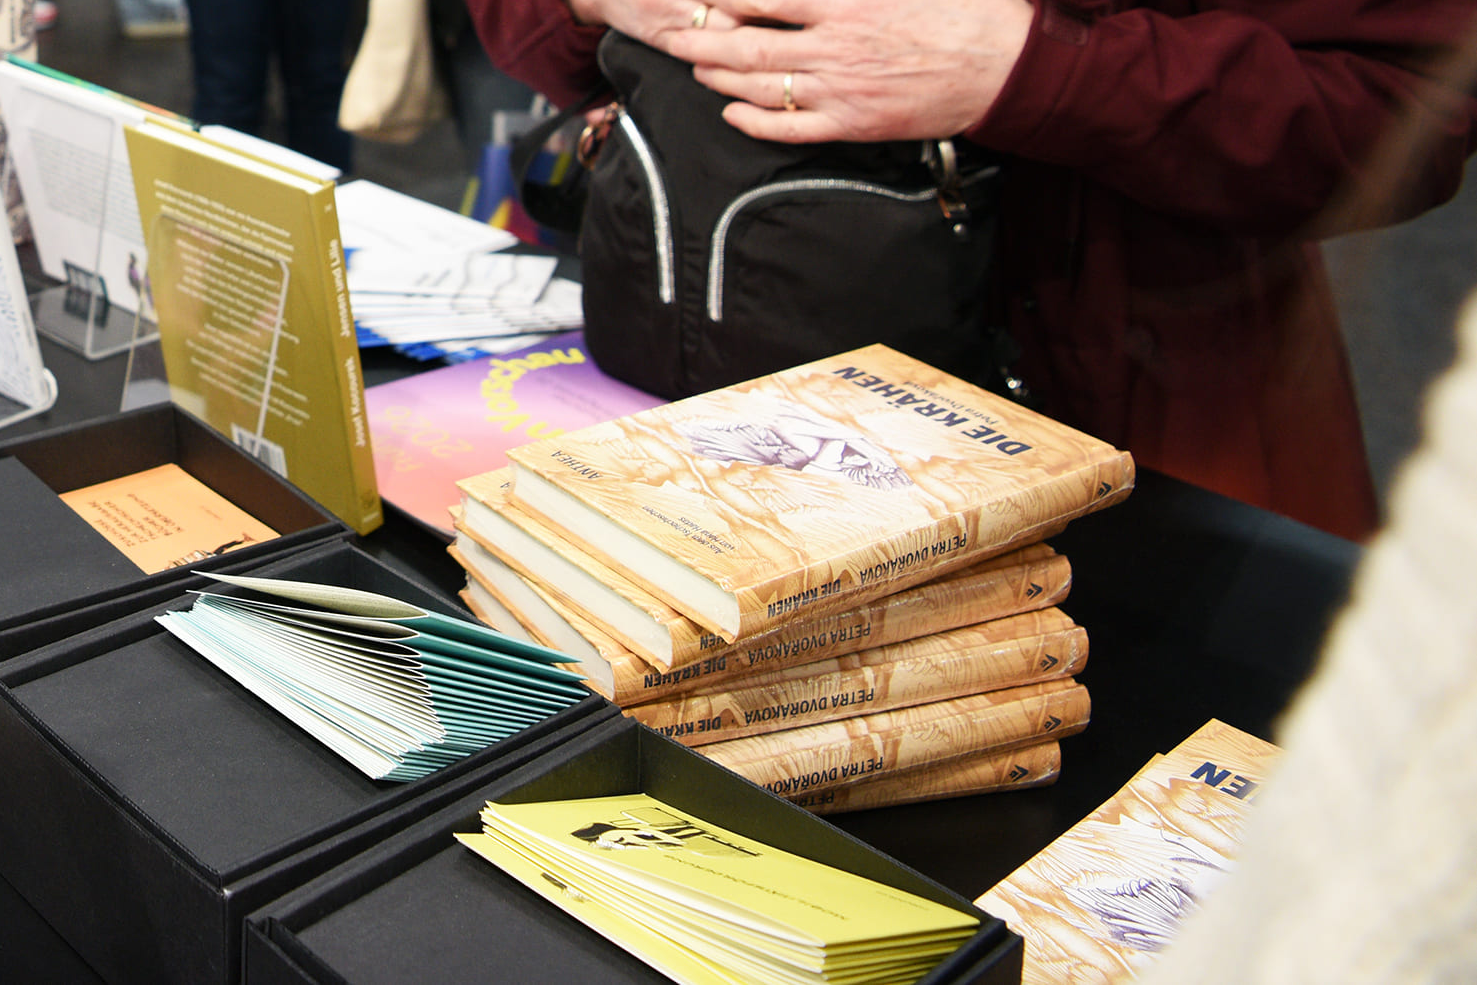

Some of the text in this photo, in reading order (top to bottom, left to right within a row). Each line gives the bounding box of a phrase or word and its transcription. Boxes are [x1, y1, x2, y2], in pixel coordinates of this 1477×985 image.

[832, 366, 1033, 456] DIE KRÄHEN
[965, 407, 999, 425] Petra
[551, 450, 603, 480] ANTHEA
[767, 533, 967, 618] PETRA DVOŘÁKOVÁ DIE KRÄHEN
[644, 622, 871, 688] PETRA DVOŘÁKOVÁ DIE KRÄHEN
[744, 697, 827, 726] DVOŘÁKOVÁ
[831, 688, 875, 709] PETRA
[697, 717, 722, 733] DIE
[762, 757, 884, 795] PETRA DVOŘÁKOV
